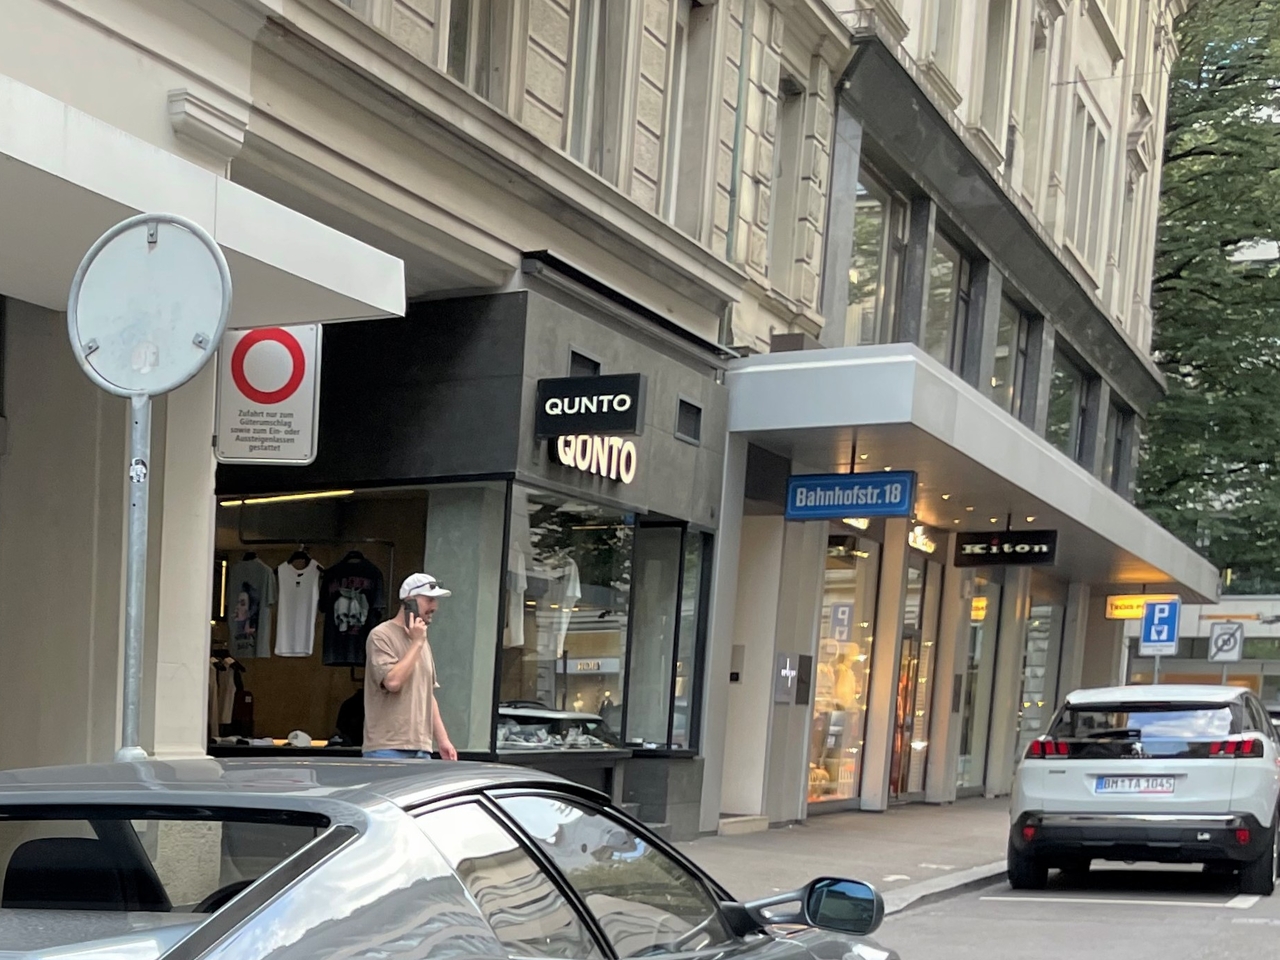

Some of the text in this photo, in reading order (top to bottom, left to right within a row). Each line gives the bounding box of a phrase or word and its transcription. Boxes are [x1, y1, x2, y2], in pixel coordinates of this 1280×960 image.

[545, 393, 632, 415] QUNTO
[238, 409, 264, 418] Zufahrt
[239, 418, 292, 428] Güterumschlag
[269, 427, 282, 435] Ein-
[235, 435, 295, 444] Aussteigenlassen
[249, 444, 280, 452] gestattet
[795, 483, 901, 507] Bahnhofstr. 18
[961, 537, 1049, 555] Kiton
[1154, 604, 1169, 624] P
